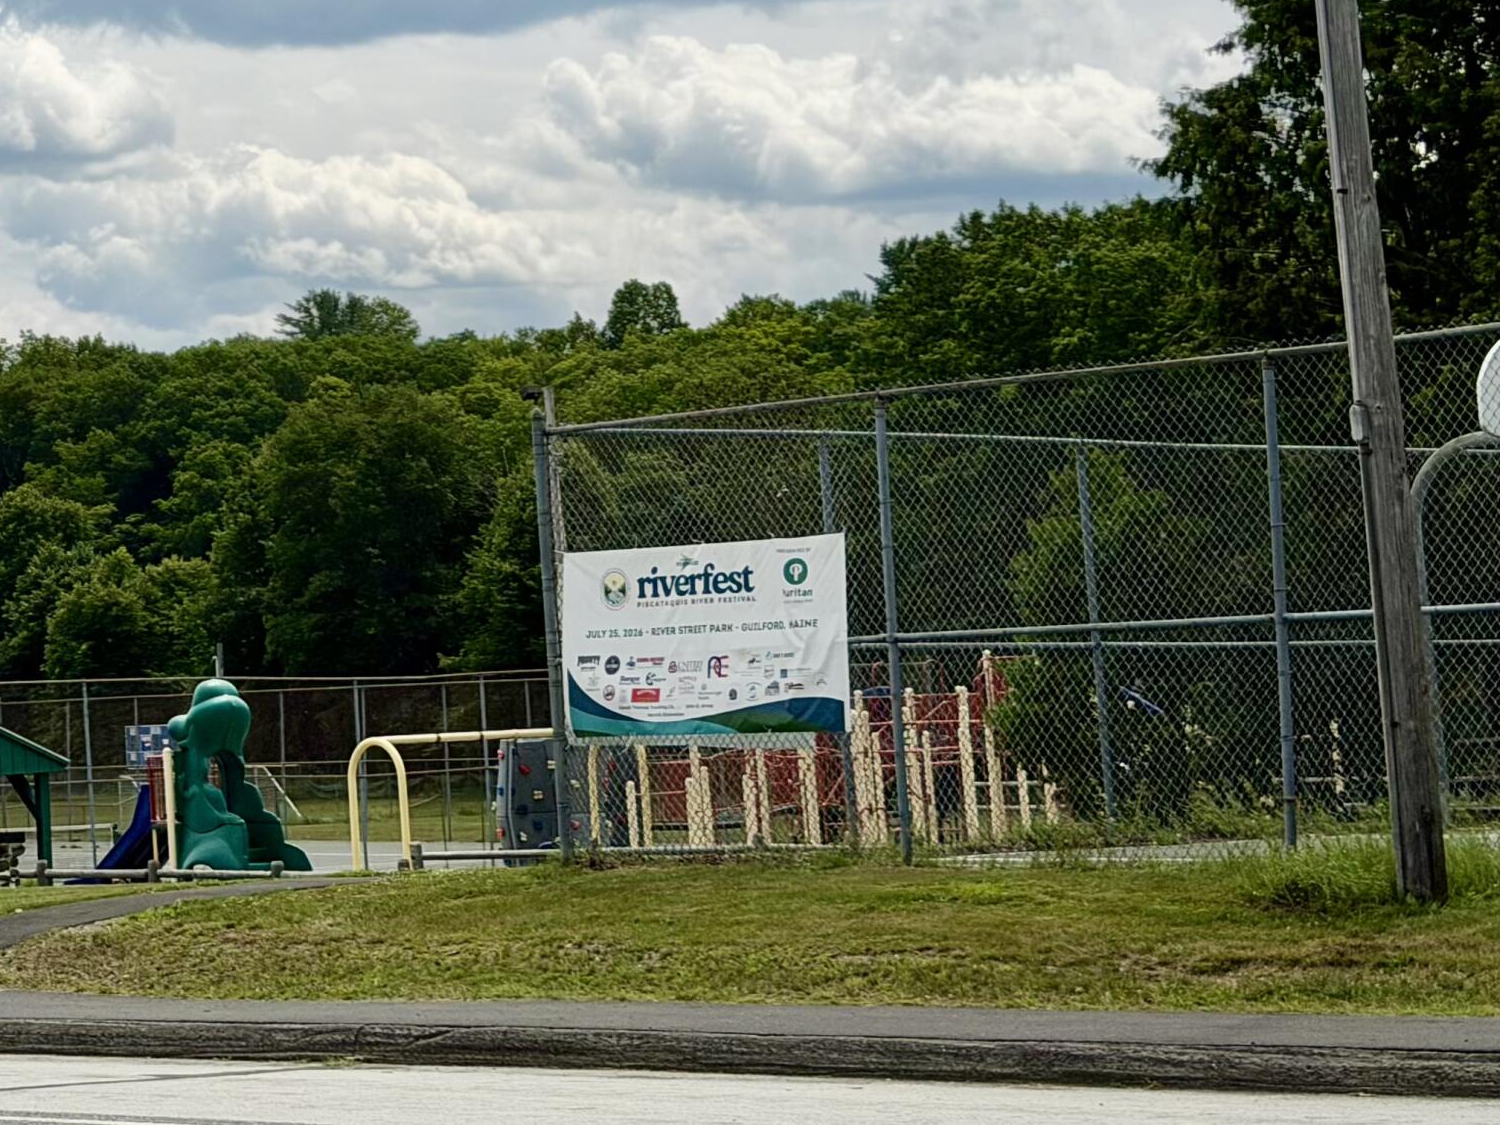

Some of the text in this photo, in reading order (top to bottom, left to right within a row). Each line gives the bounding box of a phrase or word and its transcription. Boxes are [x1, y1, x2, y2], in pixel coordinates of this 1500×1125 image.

[637, 563, 755, 599] riverfest
[637, 599, 688, 608] PISCATAQUIS
[718, 596, 756, 604] FESTIVAL
[585, 629, 607, 639] JULY
[623, 628, 643, 637] 2026
[651, 626, 676, 636] RIVER
[678, 624, 708, 634] STREET
[710, 624, 733, 633] PARK
